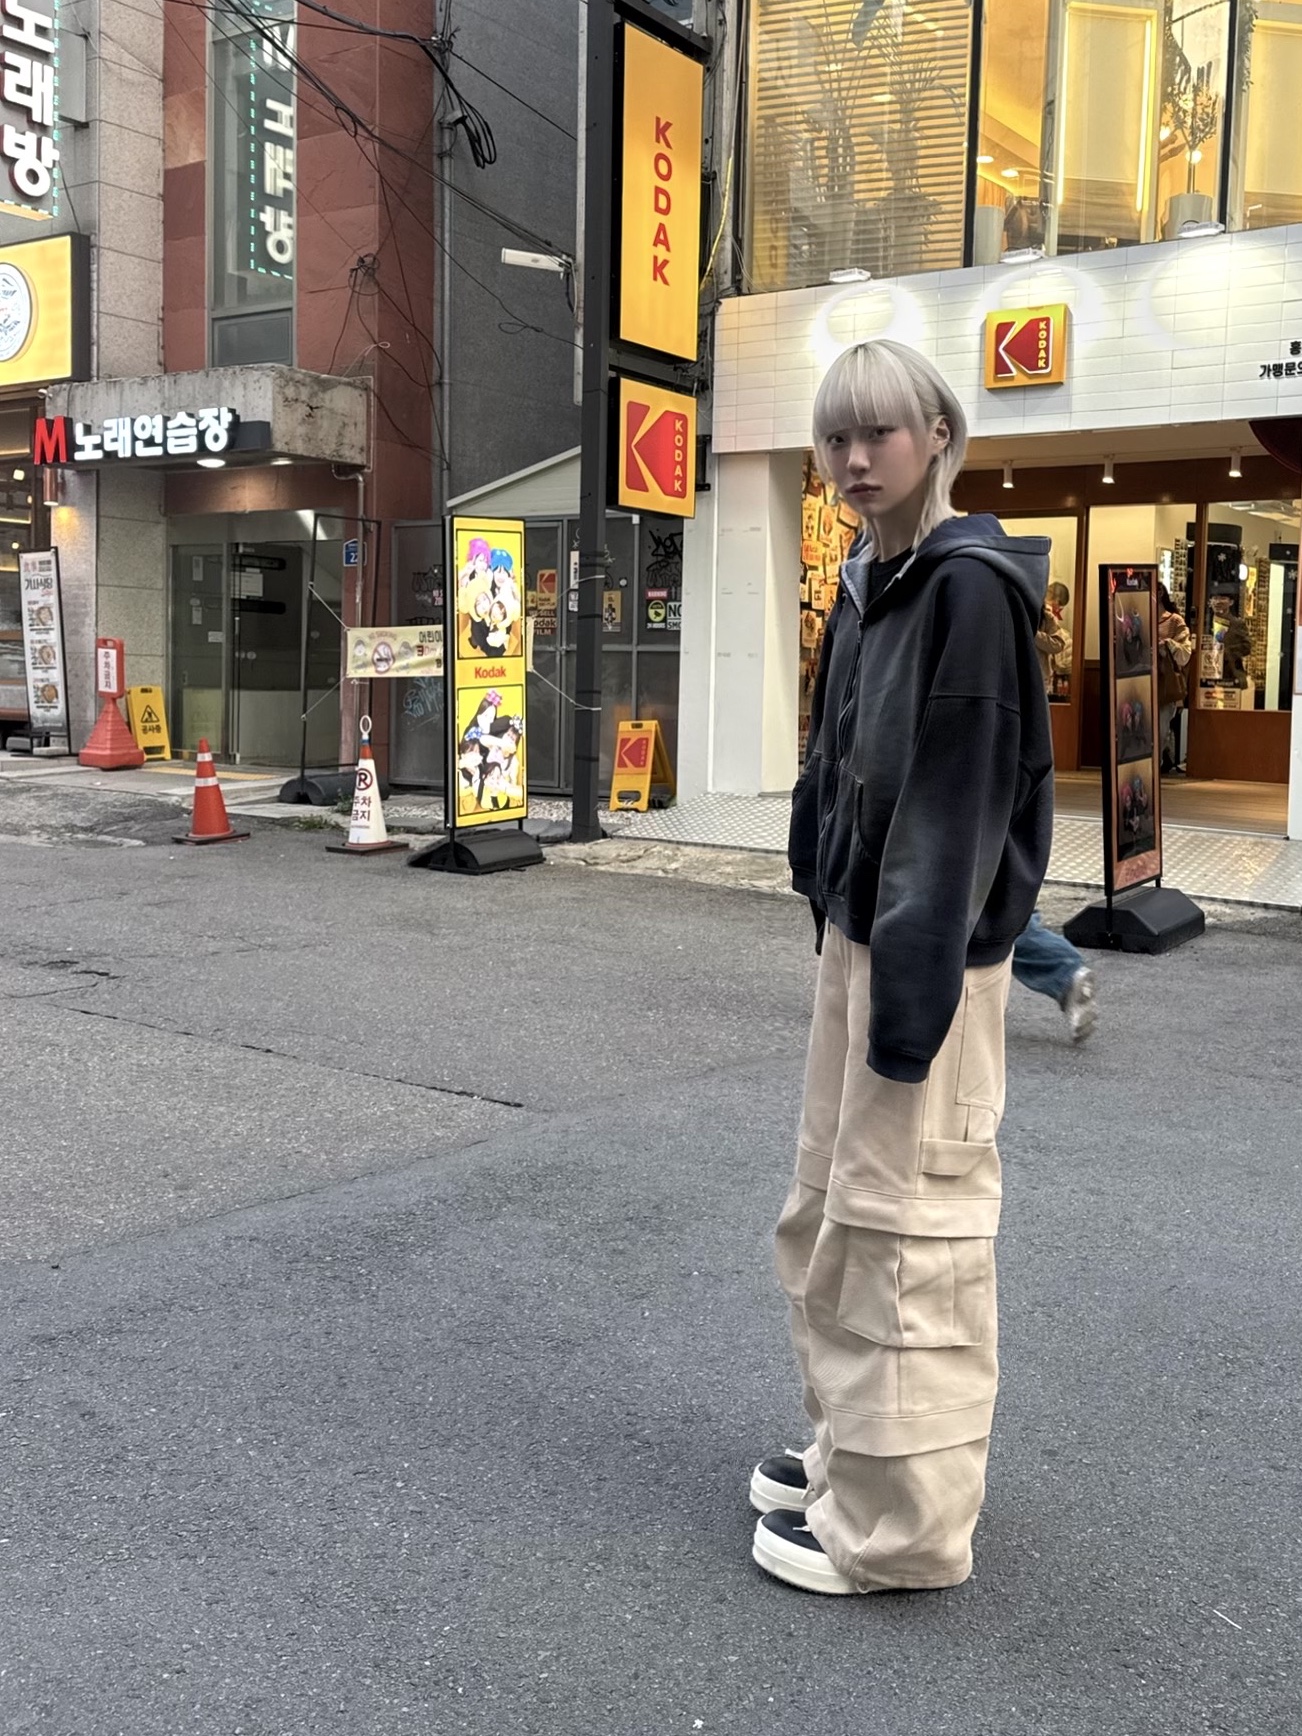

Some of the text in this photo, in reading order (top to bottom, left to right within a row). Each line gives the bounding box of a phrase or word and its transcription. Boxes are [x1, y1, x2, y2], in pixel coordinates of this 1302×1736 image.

[652, 116, 673, 287] KODAK
[1038, 320, 1047, 368] KODAK
[74, 407, 232, 461] 노래연습장
[674, 419, 684, 492] KODAK
[533, 618, 556, 627] odak
[474, 666, 507, 679] Kodak
